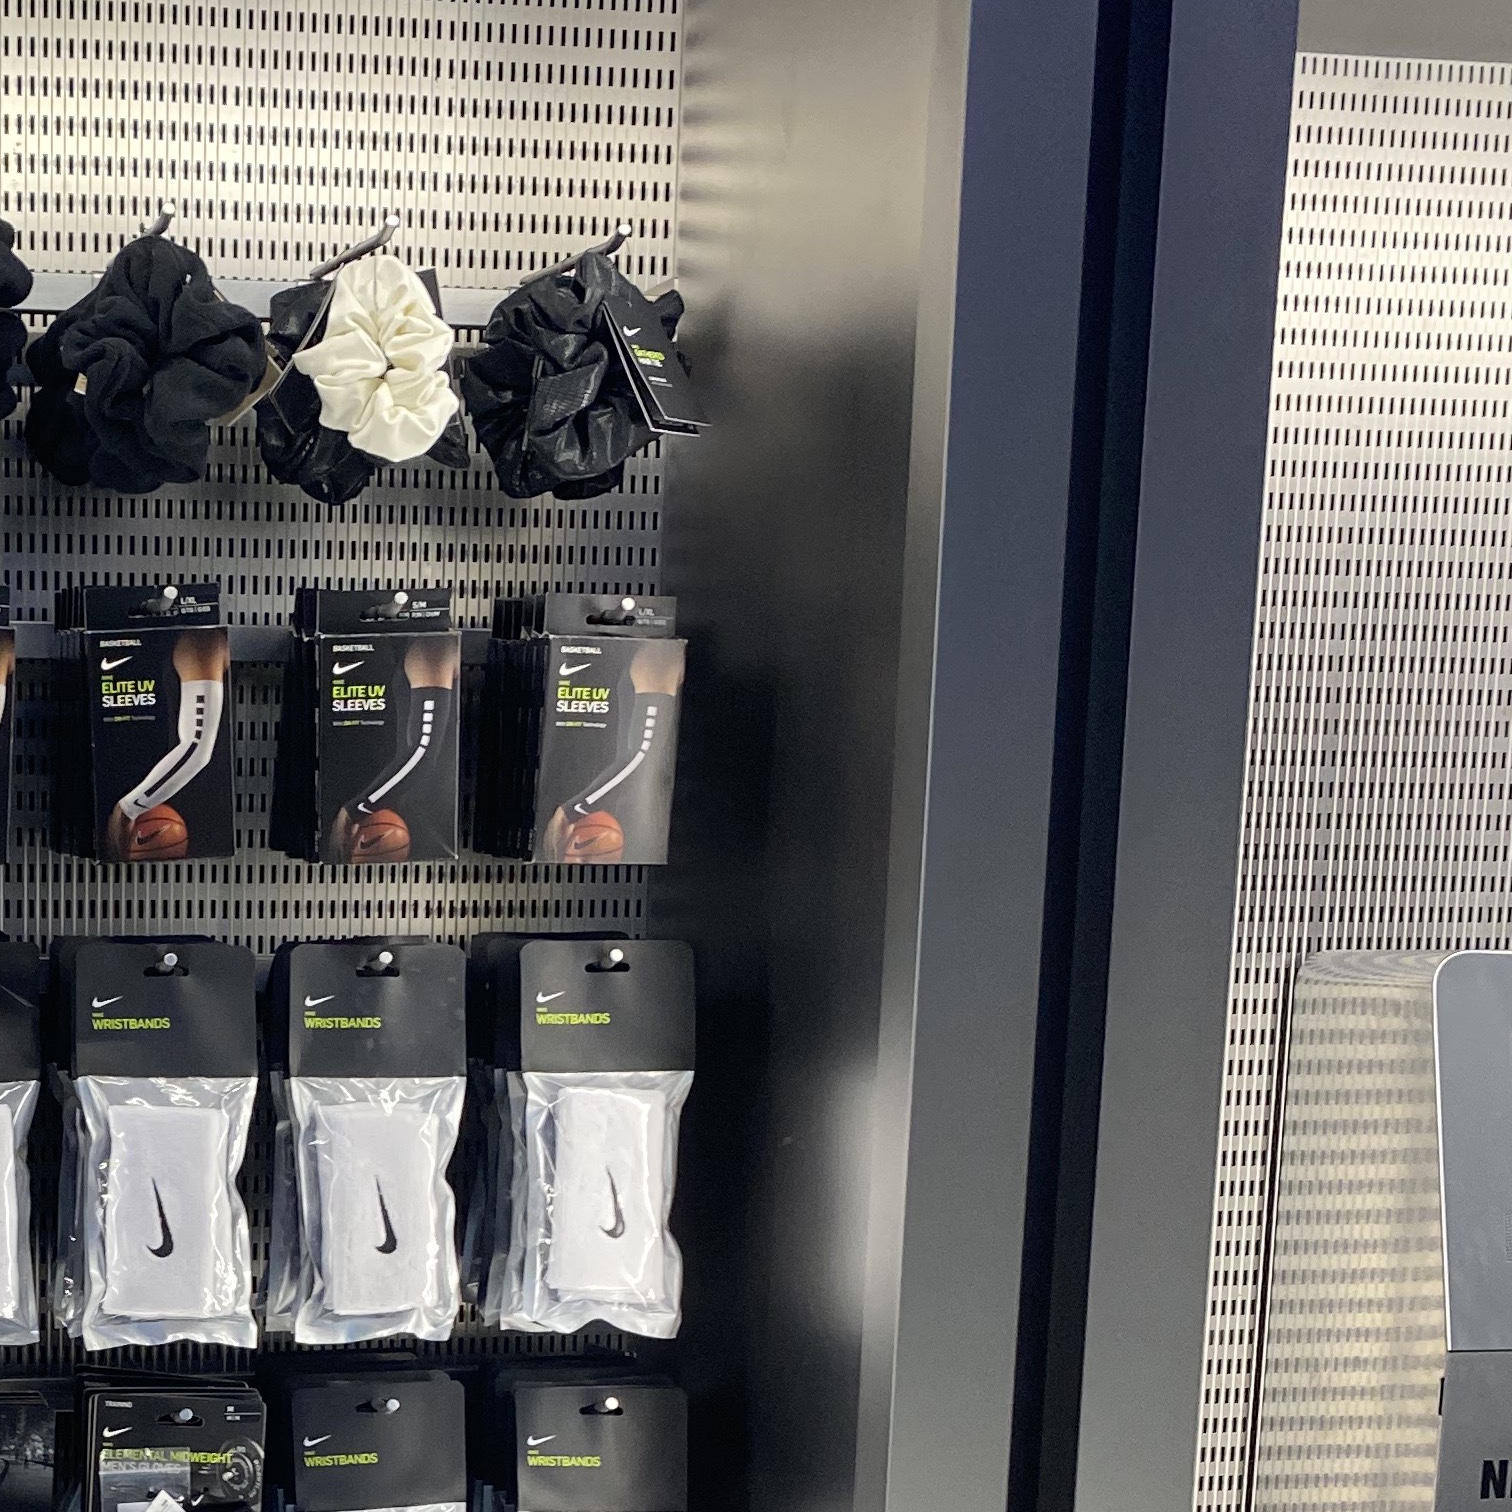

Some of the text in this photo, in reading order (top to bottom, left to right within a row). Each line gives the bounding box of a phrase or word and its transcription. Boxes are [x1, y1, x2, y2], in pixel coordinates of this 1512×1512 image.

[101, 680, 155, 694] ELITE UV
[332, 685, 386, 698] ELITE UV
[557, 687, 610, 700] ELITE UV
[102, 694, 156, 707] SLEEVES
[332, 699, 386, 712] SLEEVES
[556, 700, 609, 713] SLEEVES
[92, 1018, 170, 1030] WRISTBANDS
[304, 1017, 381, 1029] WRISTBANDS
[536, 1013, 610, 1025] WRISTBANDS
[103, 1449, 234, 1464] ELEMENTAL MIDWEIGHT
[304, 1453, 378, 1467] WRISTBANDS
[527, 1456, 601, 1467] WRISTBANDS
